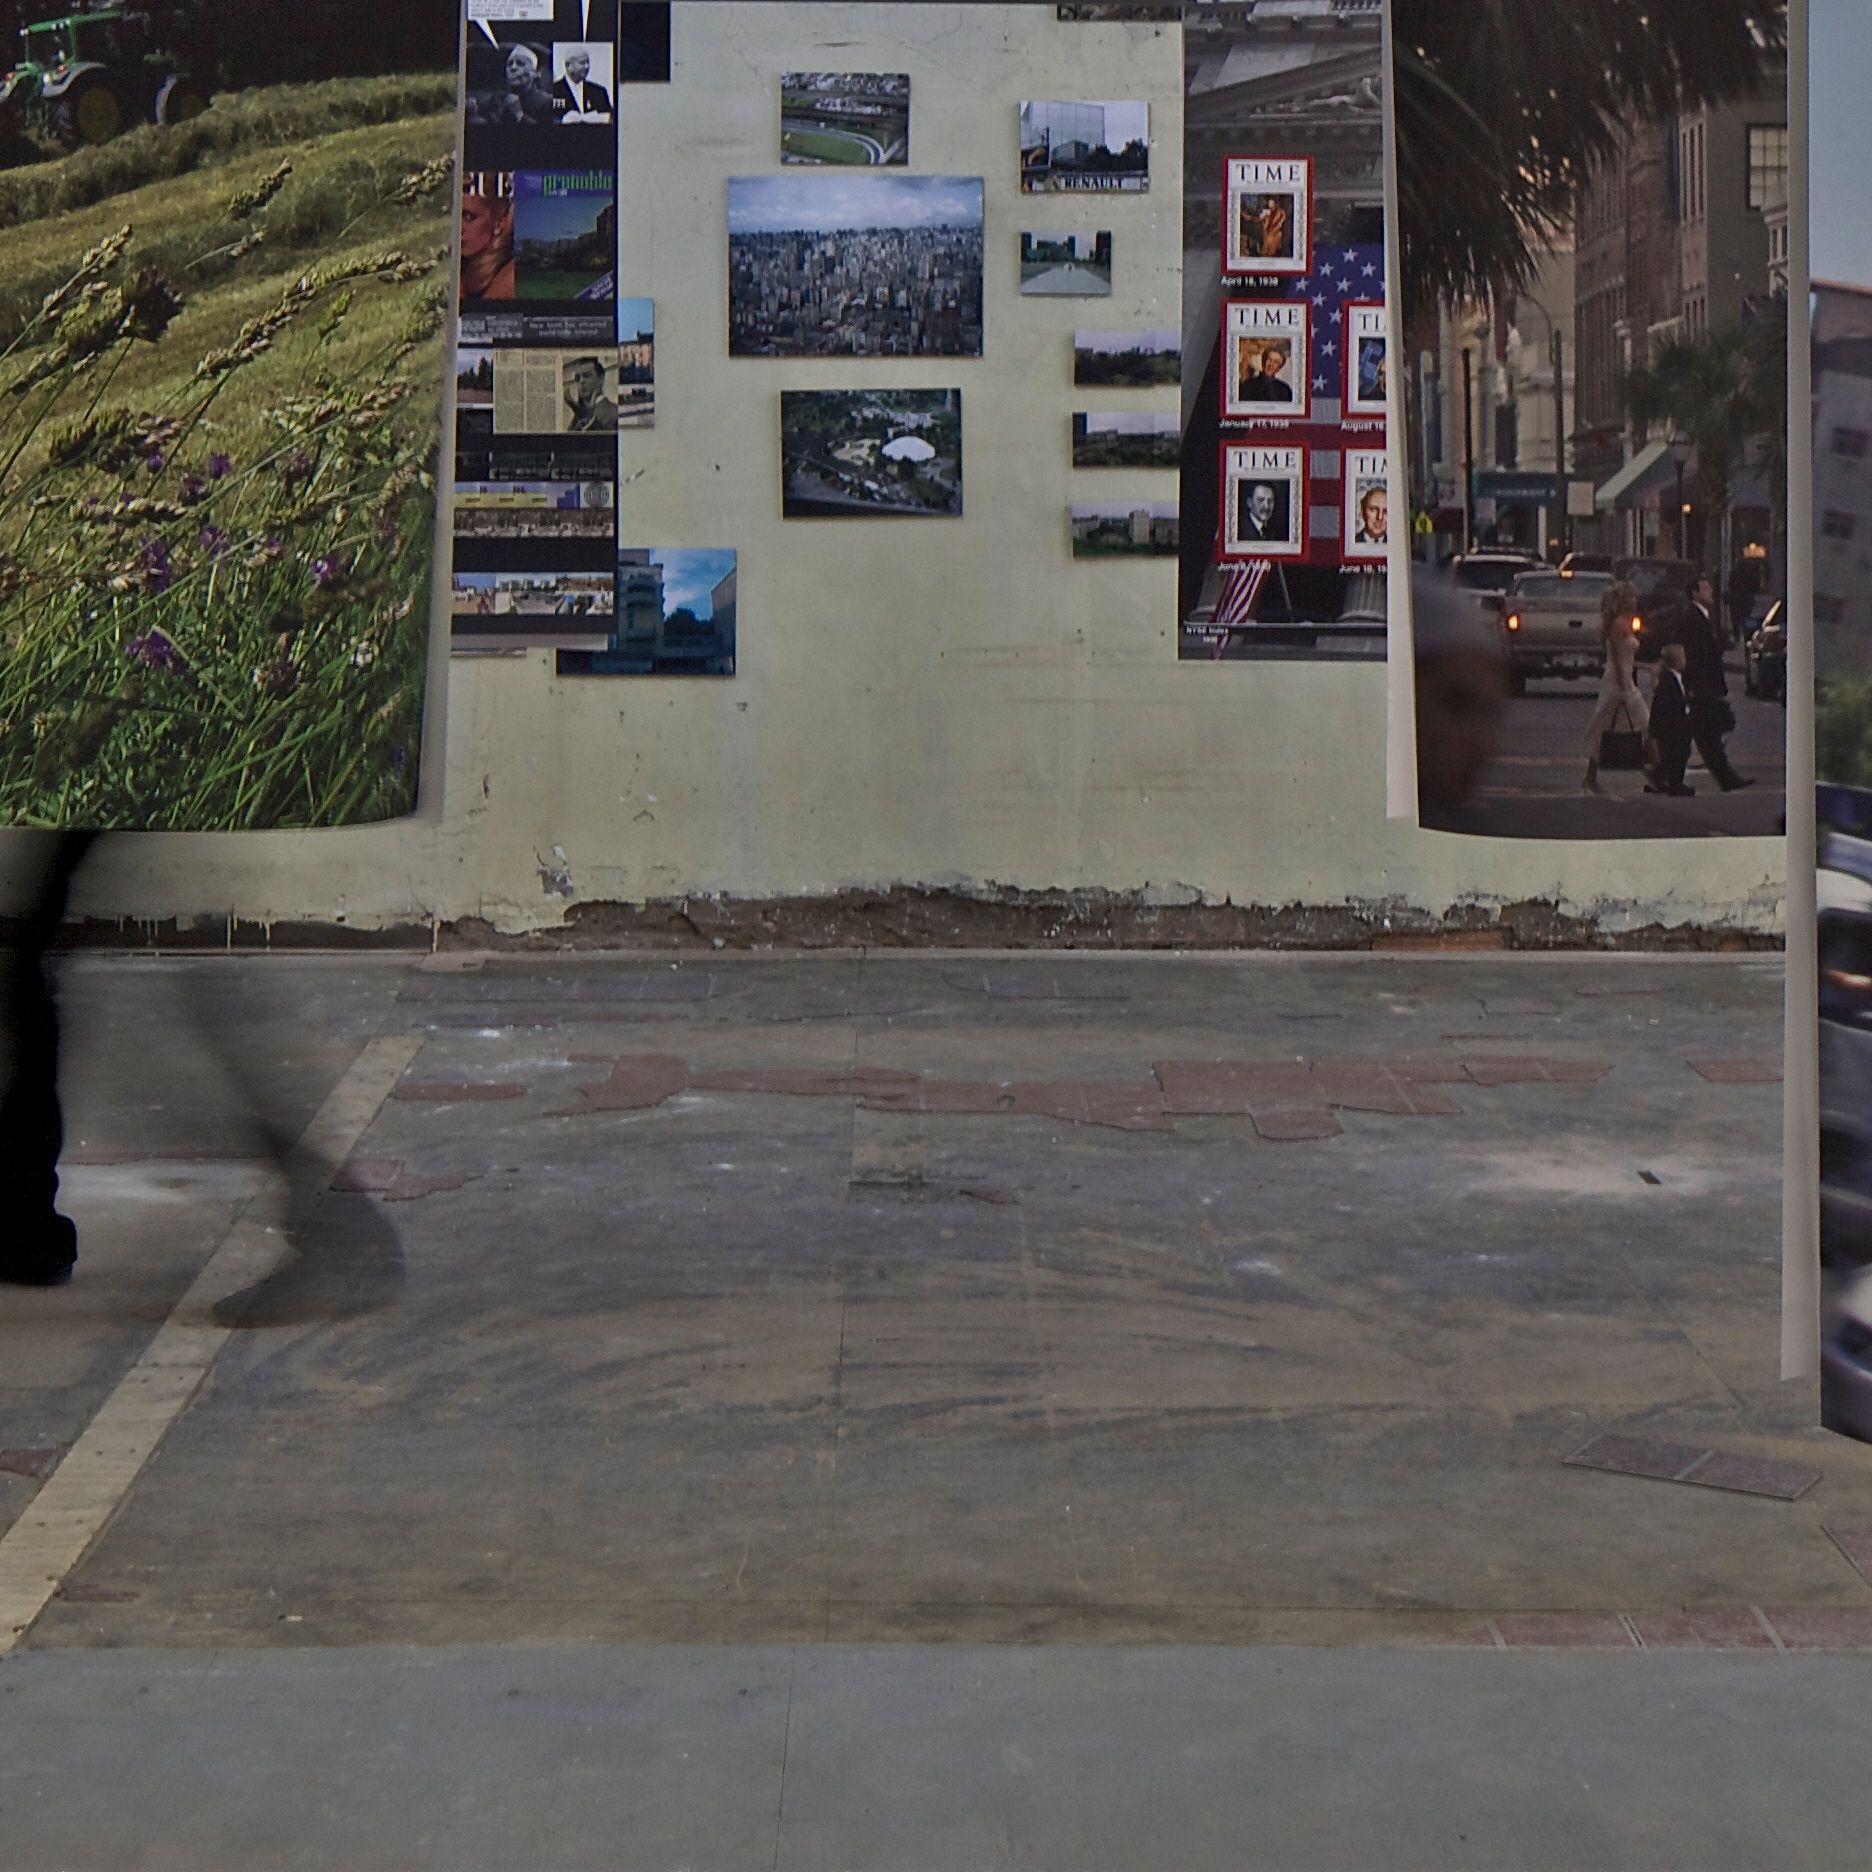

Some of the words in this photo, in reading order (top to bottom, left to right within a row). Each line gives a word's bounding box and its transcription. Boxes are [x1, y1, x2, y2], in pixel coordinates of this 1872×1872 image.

[1235, 163, 1300, 181] TIME
[1221, 276, 1242, 288] April
[1234, 307, 1300, 325] TIME
[1359, 313, 1386, 330] TI
[1340, 420, 1373, 432] August
[1233, 450, 1296, 468] TIME
[1339, 564, 1360, 575] June
